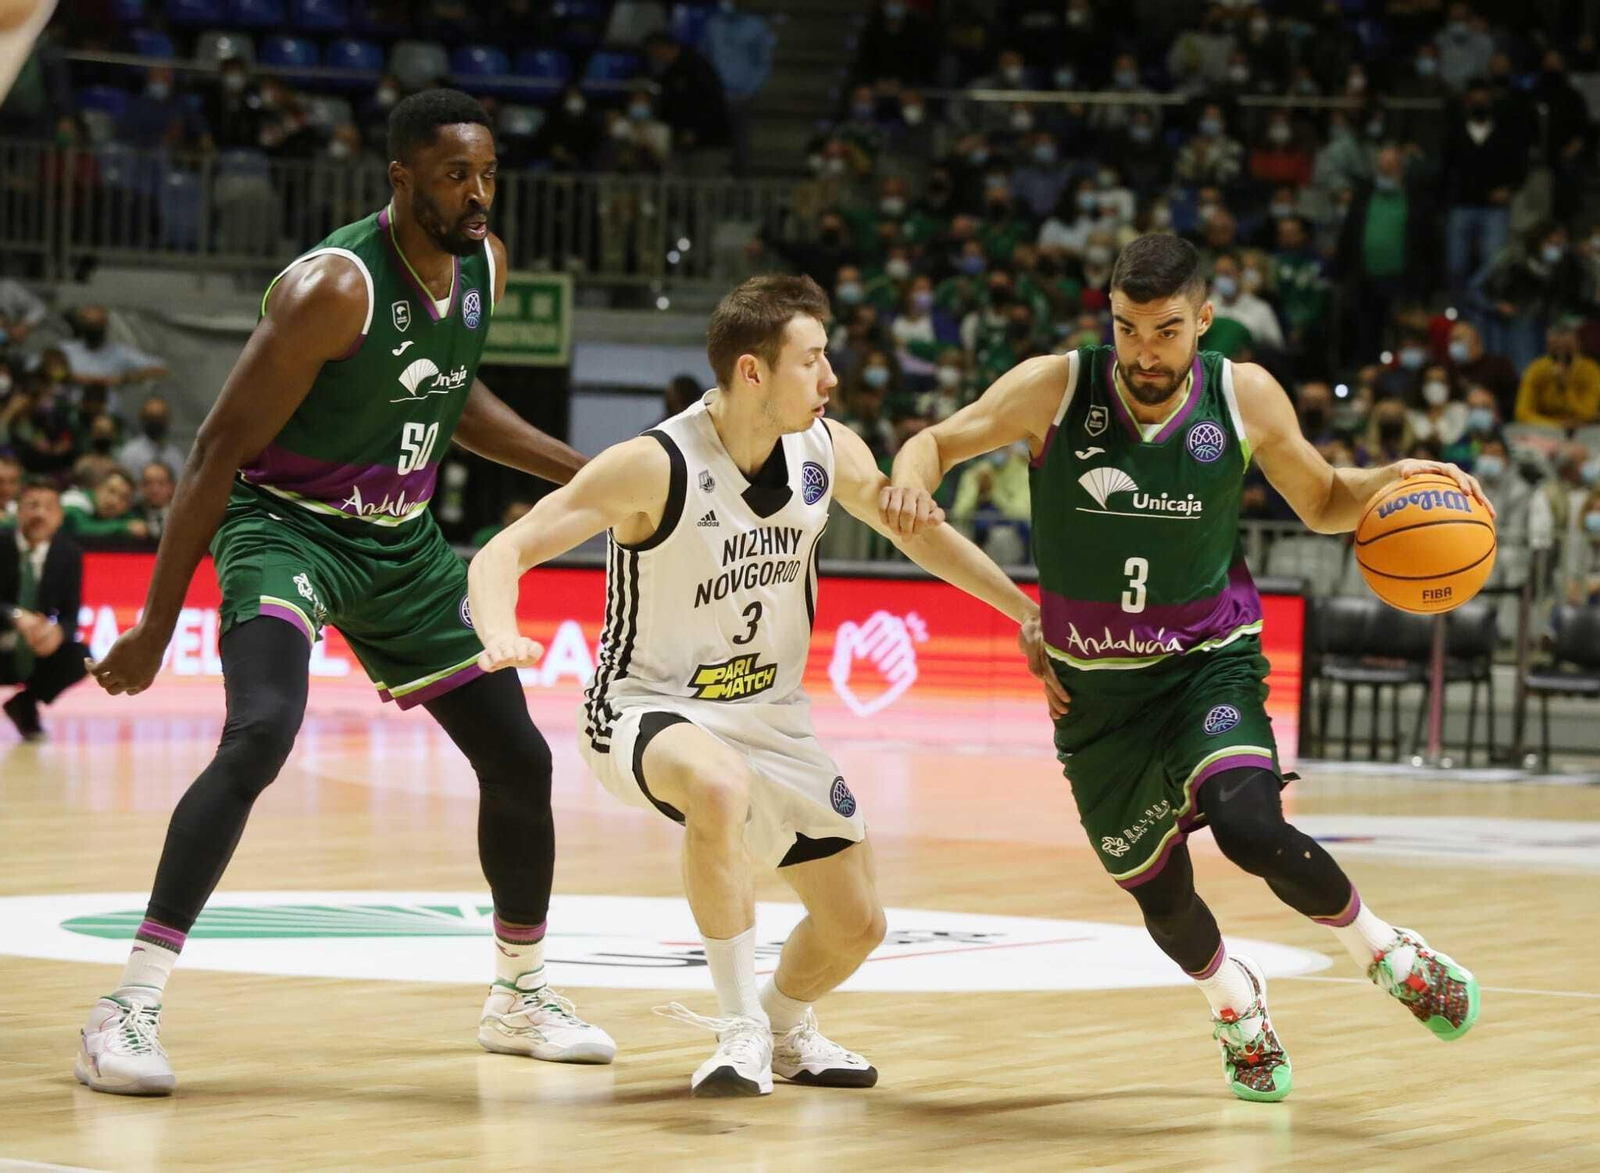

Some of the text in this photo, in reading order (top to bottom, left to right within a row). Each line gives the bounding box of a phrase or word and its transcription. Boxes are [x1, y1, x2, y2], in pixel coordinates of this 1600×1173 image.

[398, 422, 439, 475] 50
[1133, 492, 1202, 516] Unicaja
[1378, 490, 1472, 519] Wilson
[697, 519, 720, 527] adidas
[722, 526, 802, 567] NIZHNY
[694, 560, 800, 608] NOVGOROD
[1121, 557, 1148, 613] 3
[1423, 586, 1452, 600] FIBA
[732, 601, 762, 645] 3
[1065, 622, 1184, 655] Andalucía
[695, 657, 754, 684] PARI
[699, 667, 776, 699] MATCH
